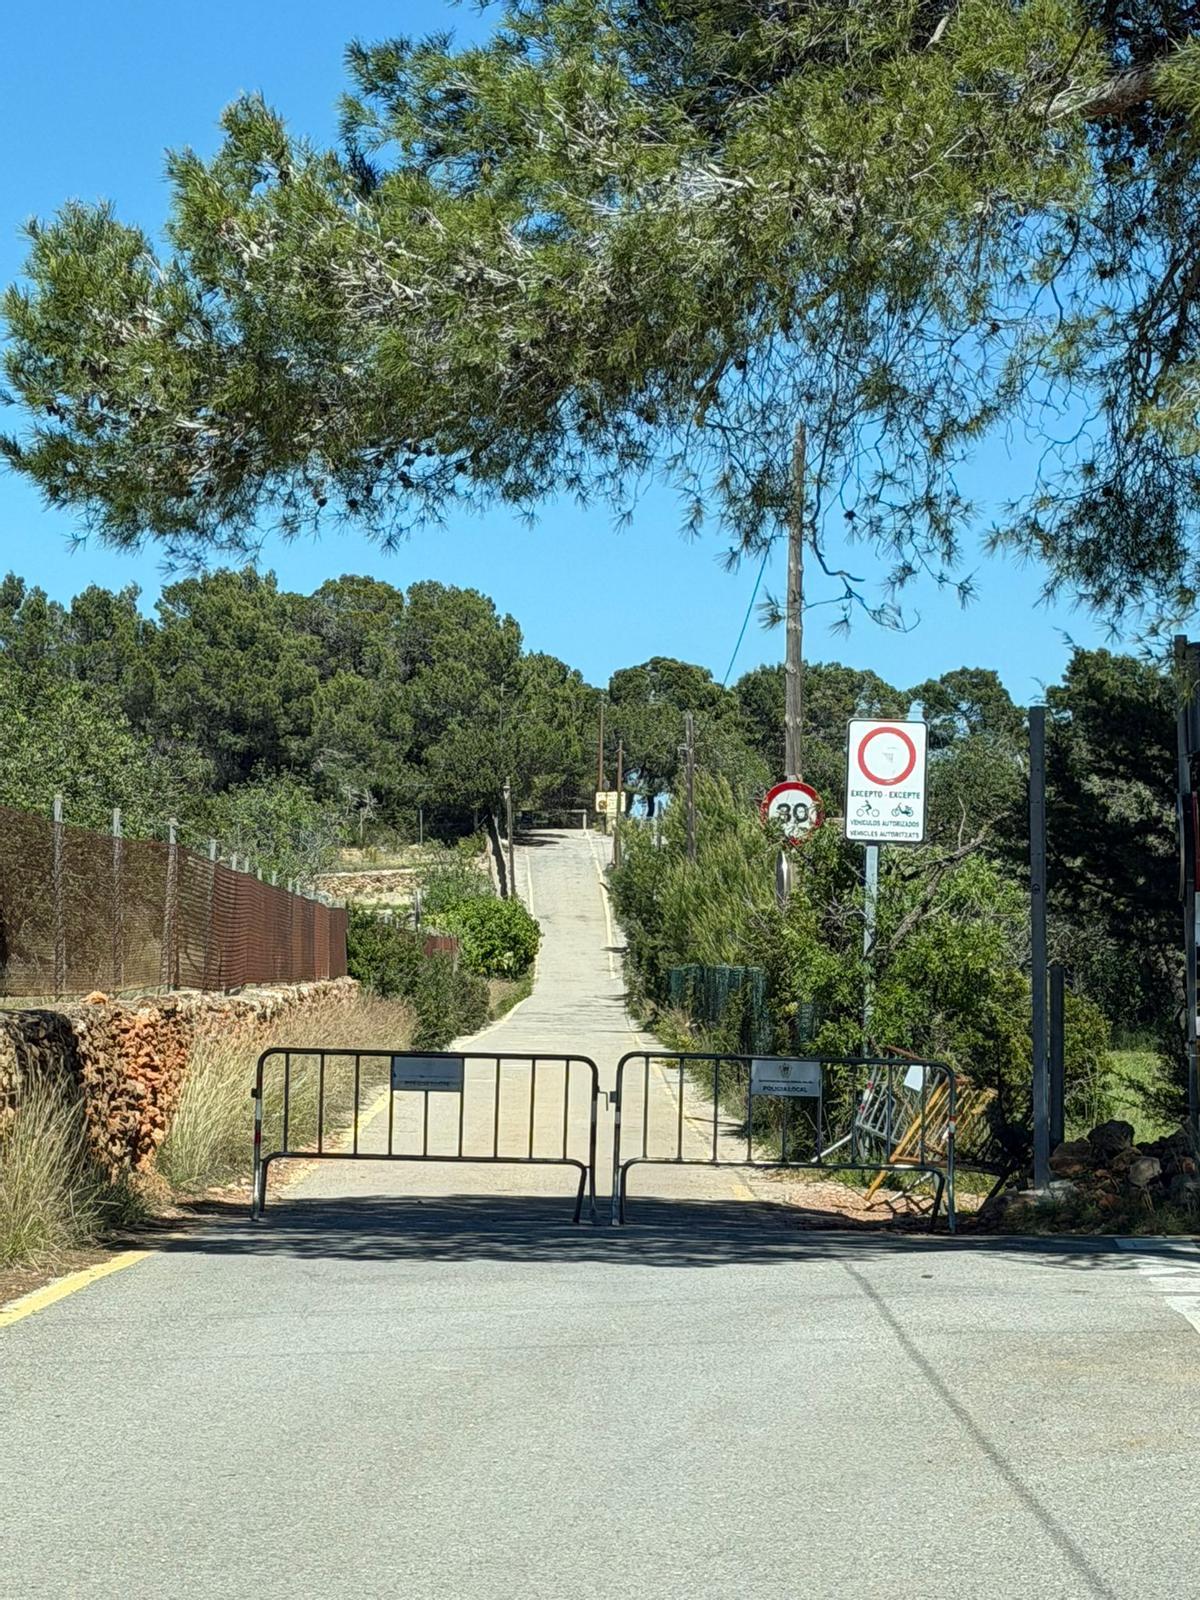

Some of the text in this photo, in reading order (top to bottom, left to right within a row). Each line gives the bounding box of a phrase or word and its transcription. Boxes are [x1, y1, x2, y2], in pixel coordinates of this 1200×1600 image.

[851, 790, 883, 798] EXCEPTO
[889, 791, 921, 799] EXCEPTE
[776, 803, 809, 823] 30
